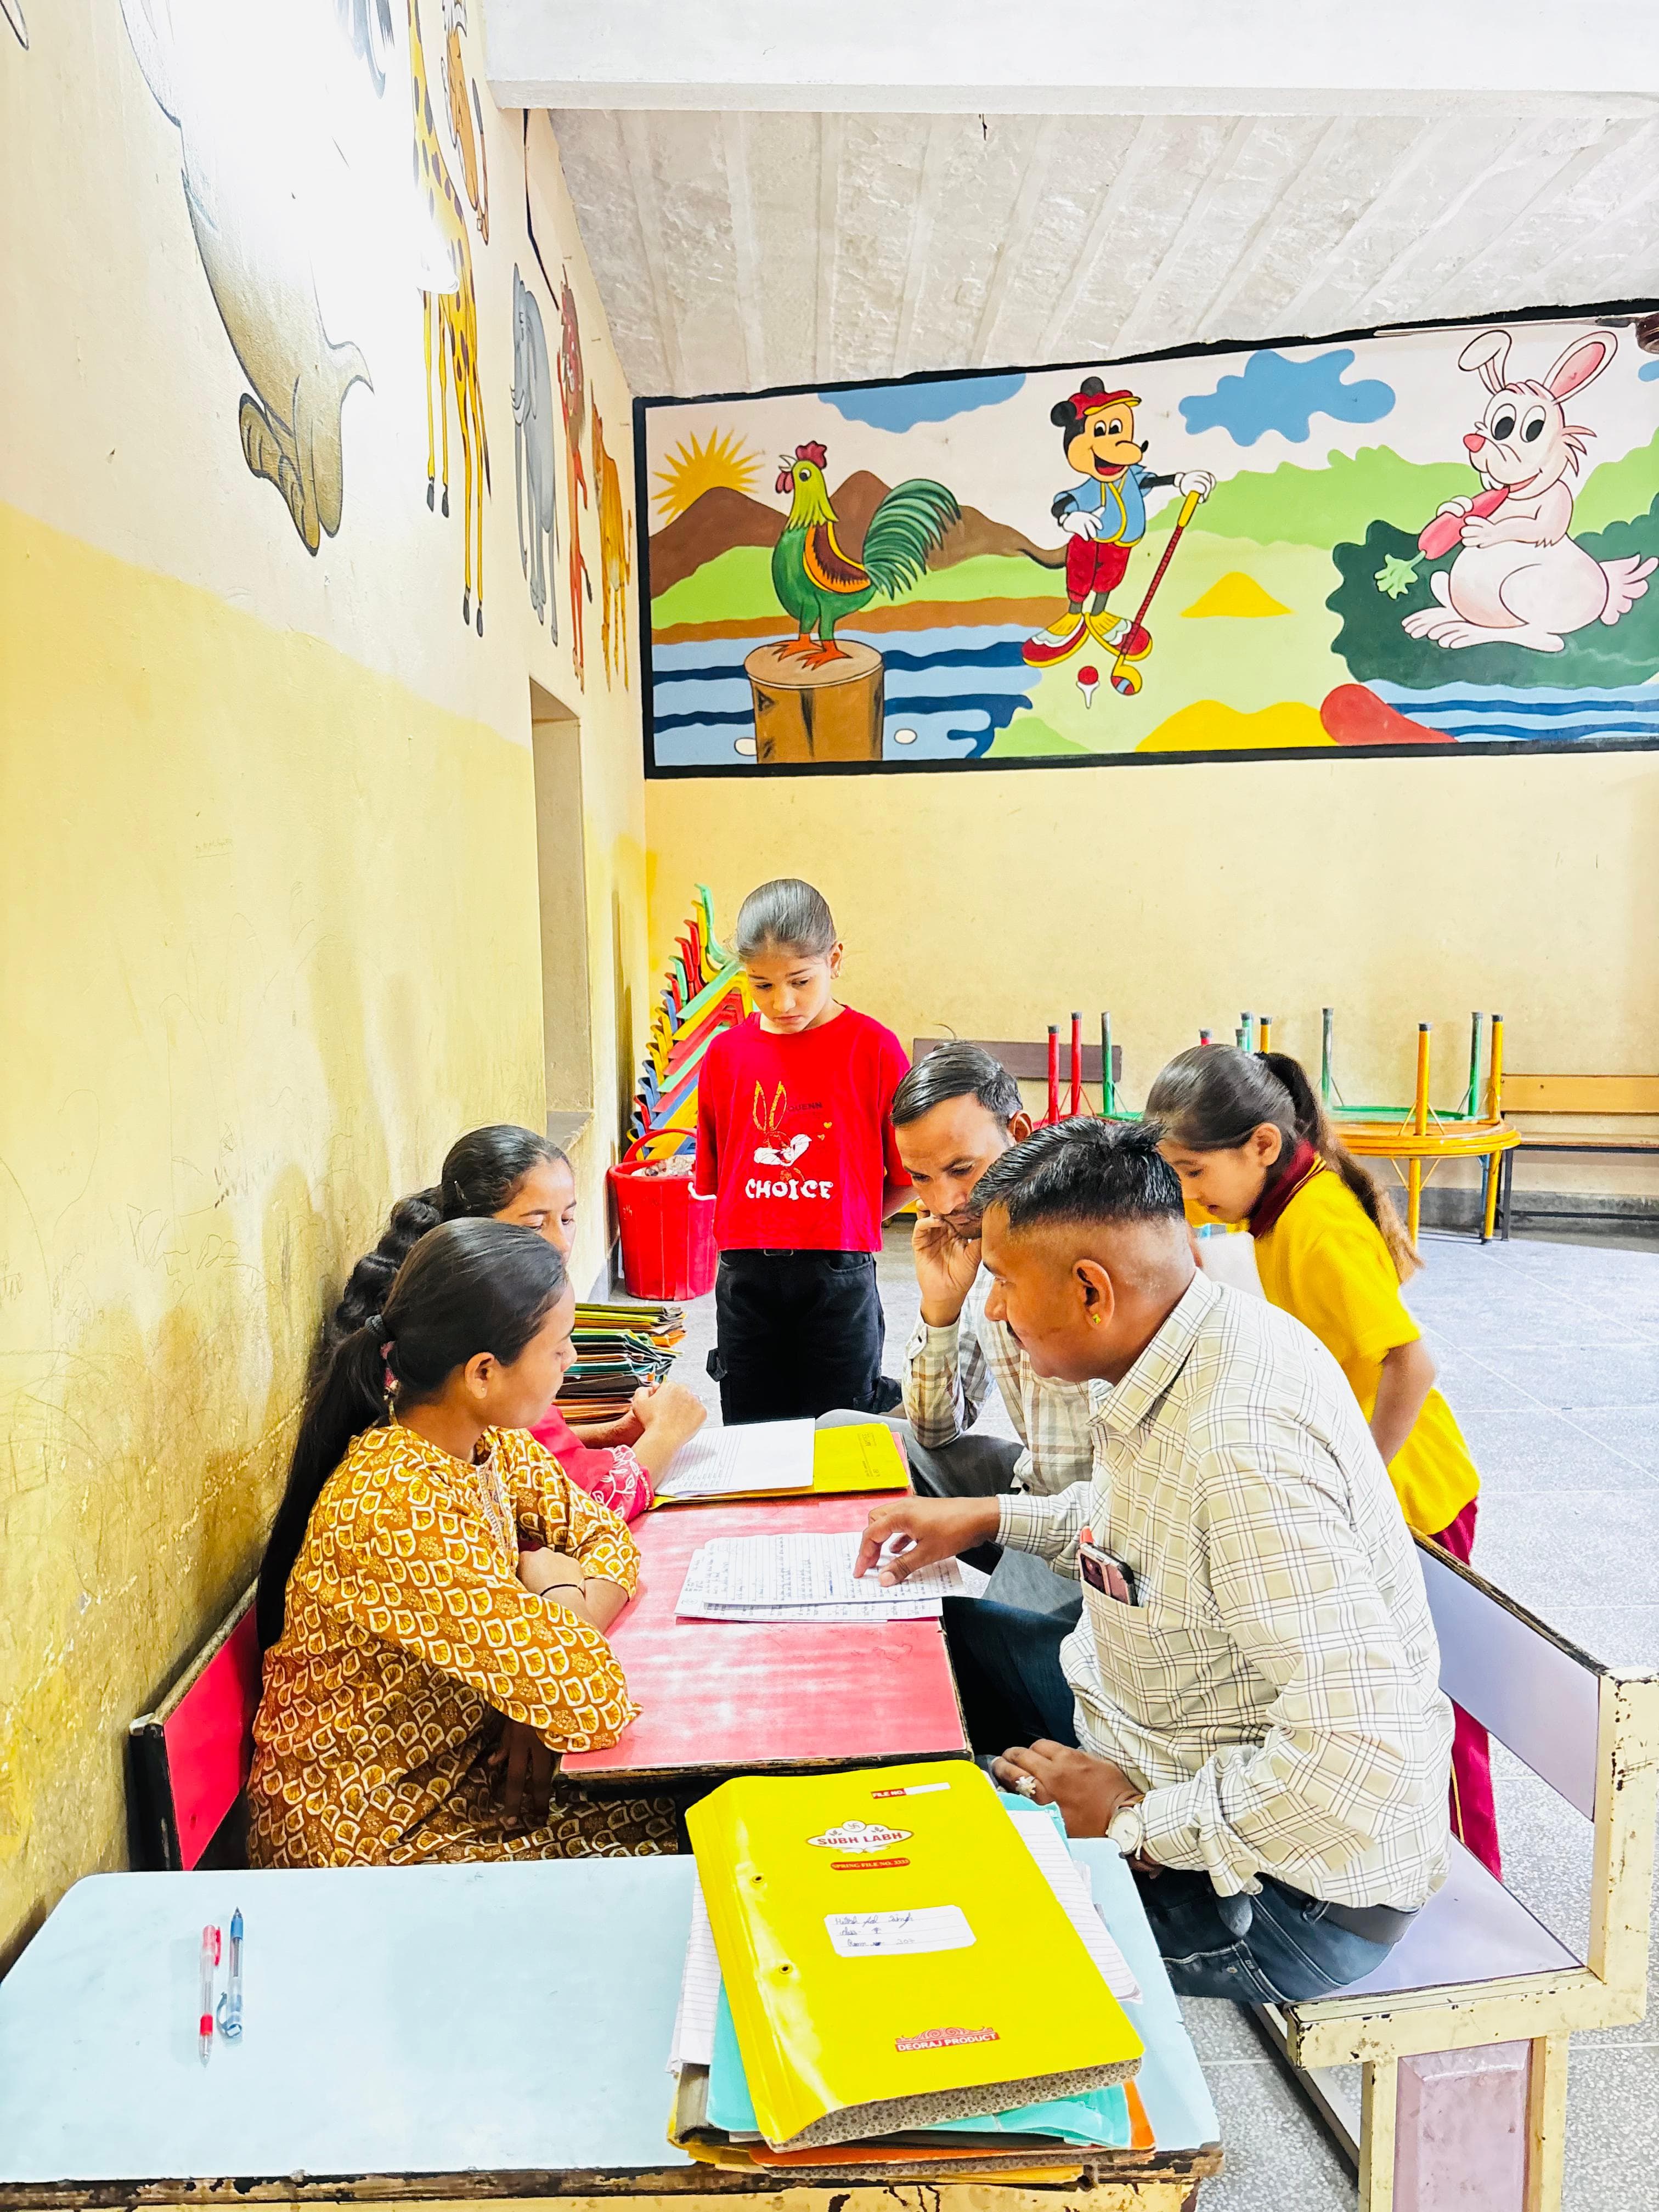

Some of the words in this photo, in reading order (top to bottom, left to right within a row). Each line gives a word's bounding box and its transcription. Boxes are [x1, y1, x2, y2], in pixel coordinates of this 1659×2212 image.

[745, 1178, 833, 1200] CHOICE
[817, 1837, 859, 1845] SUBH
[863, 1832, 902, 1842] LABH
[898, 2038, 943, 2051] DEORAJ
[944, 2033, 997, 2046] PRODUCT
